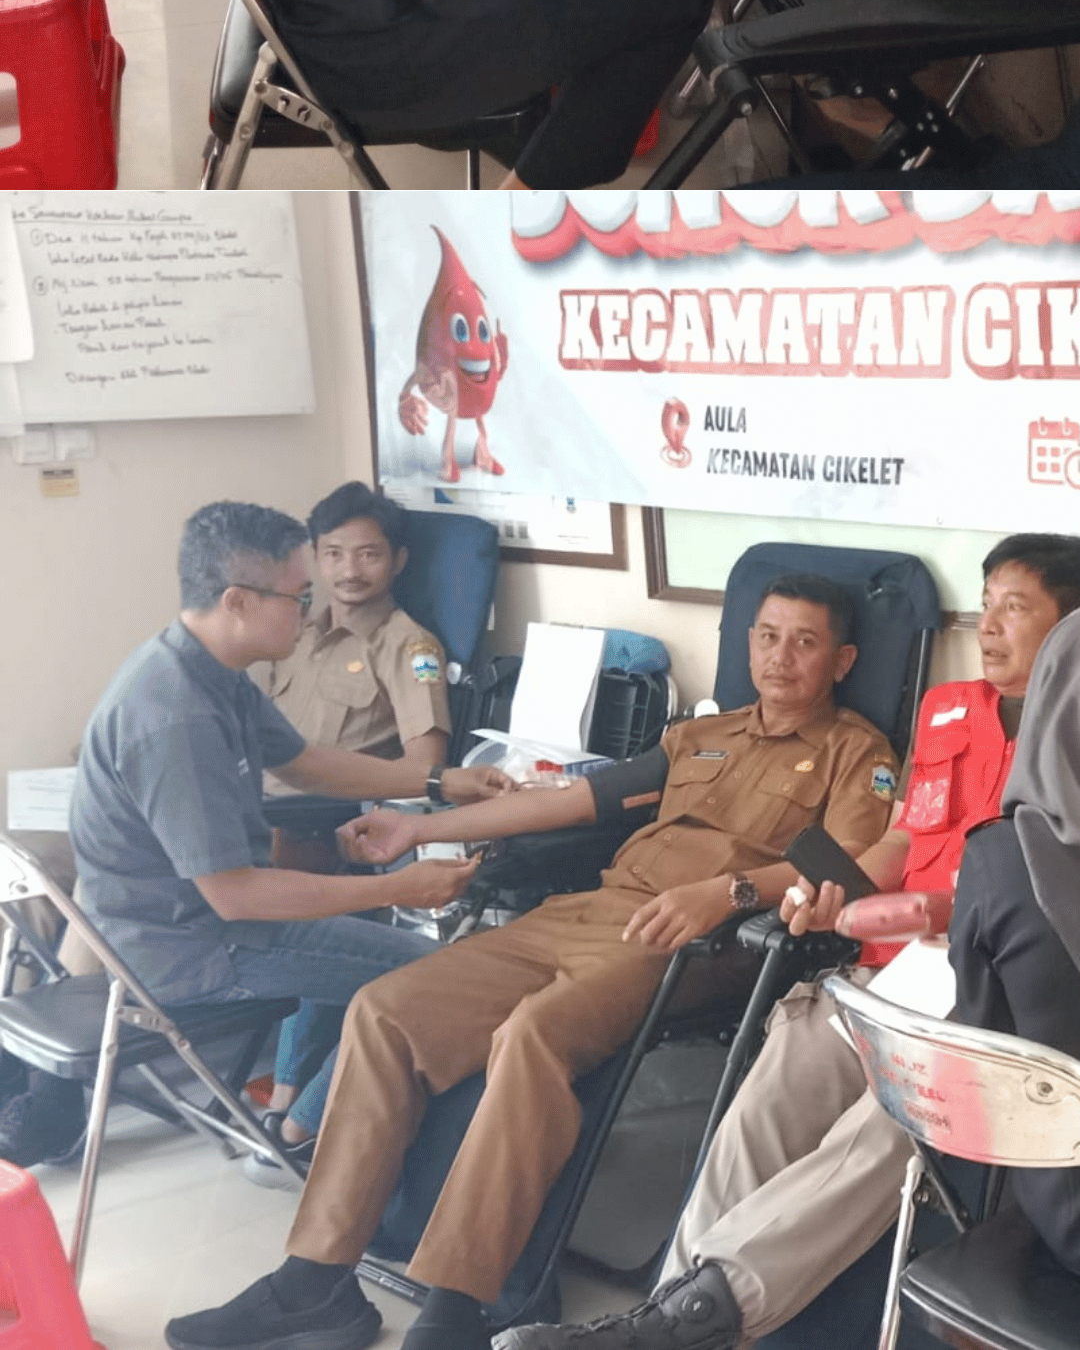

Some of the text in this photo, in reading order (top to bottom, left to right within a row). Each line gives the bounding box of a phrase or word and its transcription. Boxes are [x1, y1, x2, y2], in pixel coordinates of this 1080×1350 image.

[558, 285, 955, 378] KECAMATAN
[703, 405, 747, 434] AULA
[706, 448, 905, 486] KECAMATAN CIKELET
